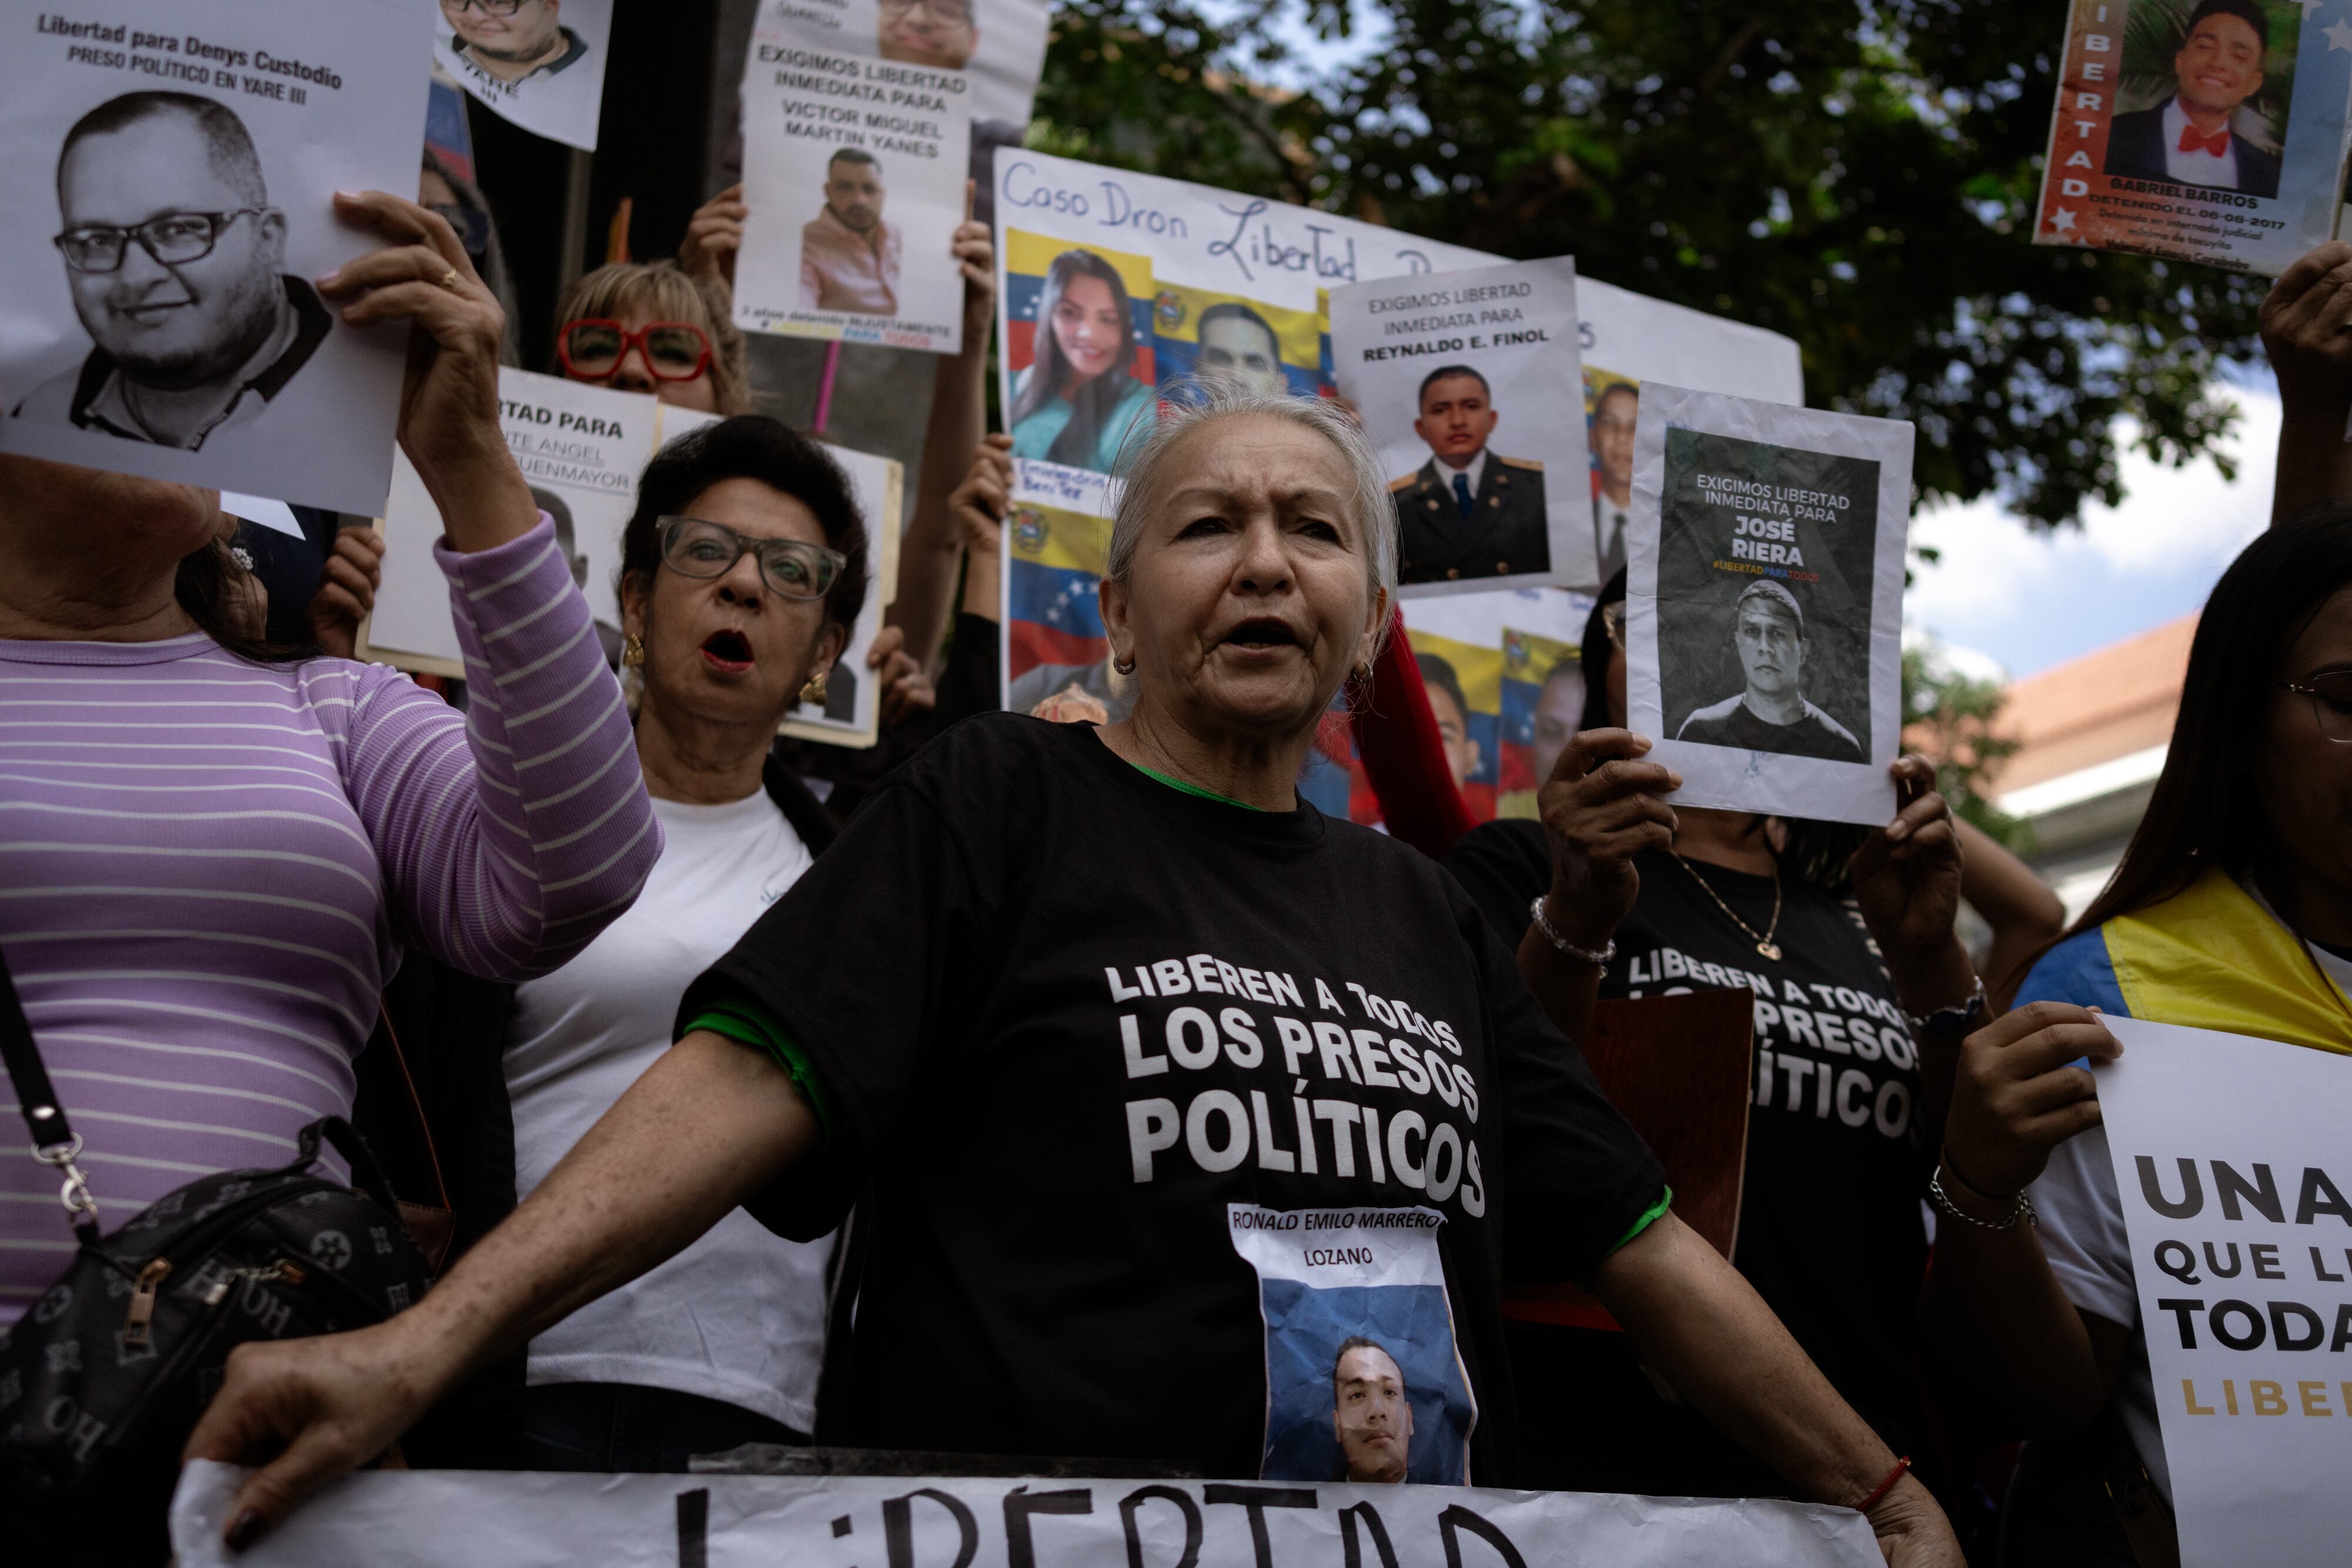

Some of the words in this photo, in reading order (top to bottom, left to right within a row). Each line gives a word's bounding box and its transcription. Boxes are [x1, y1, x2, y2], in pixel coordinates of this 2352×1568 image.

[38, 13, 126, 44] Libertad
[131, 29, 178, 55] para
[186, 37, 248, 68] Denys
[255, 51, 342, 90] Custodio
[757, 44, 860, 78] EXIGIMOS
[866, 63, 966, 94] LIBERTAD
[68, 45, 123, 69] PRESO
[216, 69, 237, 90] EN
[243, 77, 285, 101] YARE
[775, 70, 886, 103] INMEDIATA
[891, 89, 947, 112] PARA
[781, 99, 858, 122] VICTOR
[865, 112, 944, 139] MIGUEL
[784, 119, 865, 145] MARTIN
[871, 133, 939, 159] YANES
[1003, 162, 1090, 216] Caso
[1098, 182, 1188, 238] Dron
[2089, 194, 2173, 213] DETENIDO
[2177, 206, 2196, 216] EL
[2110, 178, 2183, 199] GABRIEL
[2186, 188, 2260, 209] BARROS
[1369, 291, 1451, 314] EXIGIMOS
[1454, 282, 1532, 305] LIBERTAD
[1385, 313, 1476, 336] INMEDIATA
[1480, 307, 1524, 326] PARA
[1363, 337, 1464, 363] REYNALDO
[1471, 336, 1488, 349] E.
[1494, 329, 1550, 347] FINOL
[558, 412, 624, 439] PARA
[539, 437, 605, 462] ANGEL
[1697, 474, 1772, 498] EXIGIMOS
[1776, 487, 1850, 510] LIBERTAD
[1705, 491, 1790, 516] INMEDIATA
[1795, 504, 1837, 523] PARA
[1735, 515, 1796, 542] JOSÉ
[1732, 538, 1805, 567] RIERA
[1629, 947, 1774, 999] LIBEREN
[1784, 978, 1812, 1005] A
[1104, 954, 1305, 1008] LIBEREN
[1315, 977, 1346, 1017] A
[1345, 982, 1463, 1057] TODOS
[1119, 1006, 1264, 1079] LOS
[1273, 1015, 1479, 1124] PRESOS
[1125, 1078, 1485, 1218] POLÍTICOS
[1233, 1211, 1298, 1231] RONALD
[1304, 1212, 1356, 1231] EMILO
[1358, 1211, 1440, 1229] MARRERO
[1304, 1246, 1373, 1266] LOZANO
[2154, 1239, 2286, 1285] QUE
[2181, 1379, 2352, 1417] LIBE
